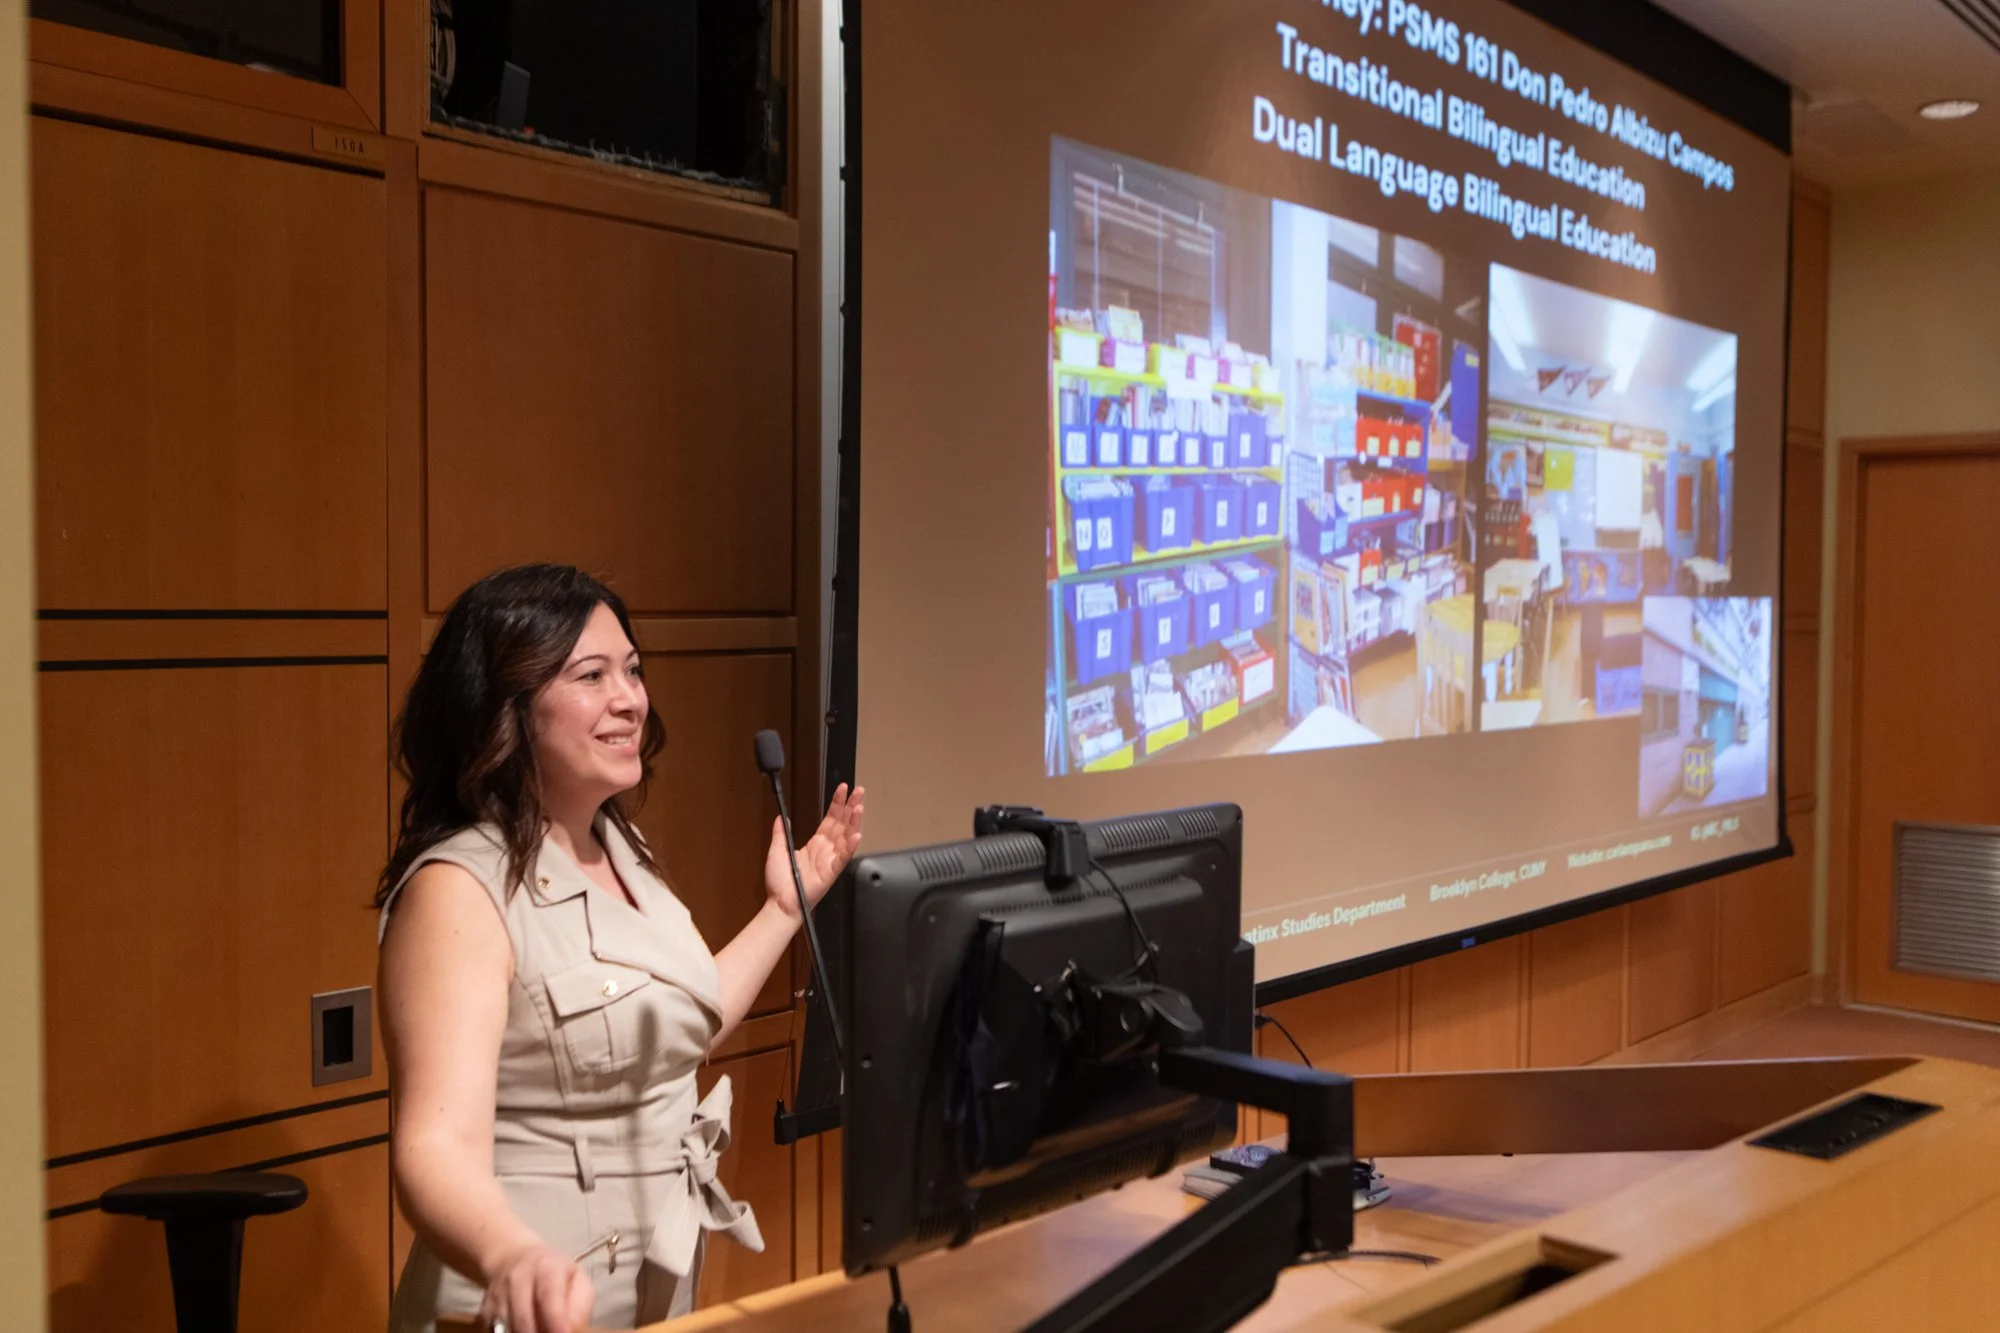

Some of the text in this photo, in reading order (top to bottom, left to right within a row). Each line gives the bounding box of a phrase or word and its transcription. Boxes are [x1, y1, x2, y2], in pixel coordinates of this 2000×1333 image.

[1252, 95, 1656, 274] Dual Language Bilingual Education
[1276, 21, 1645, 211] Transitional Bilingual Education
[1387, 0, 1460, 65] PSMS
[1464, 32, 1498, 83] 161
[1501, 49, 1546, 104] Don
[1549, 72, 1608, 133] Pedro
[1610, 104, 1666, 161] Albizu
[1668, 131, 1735, 192] Campos
[1242, 893, 1407, 945] atinx Studies Department
[1429, 859, 1547, 902] Brooklyn College, CUNY
